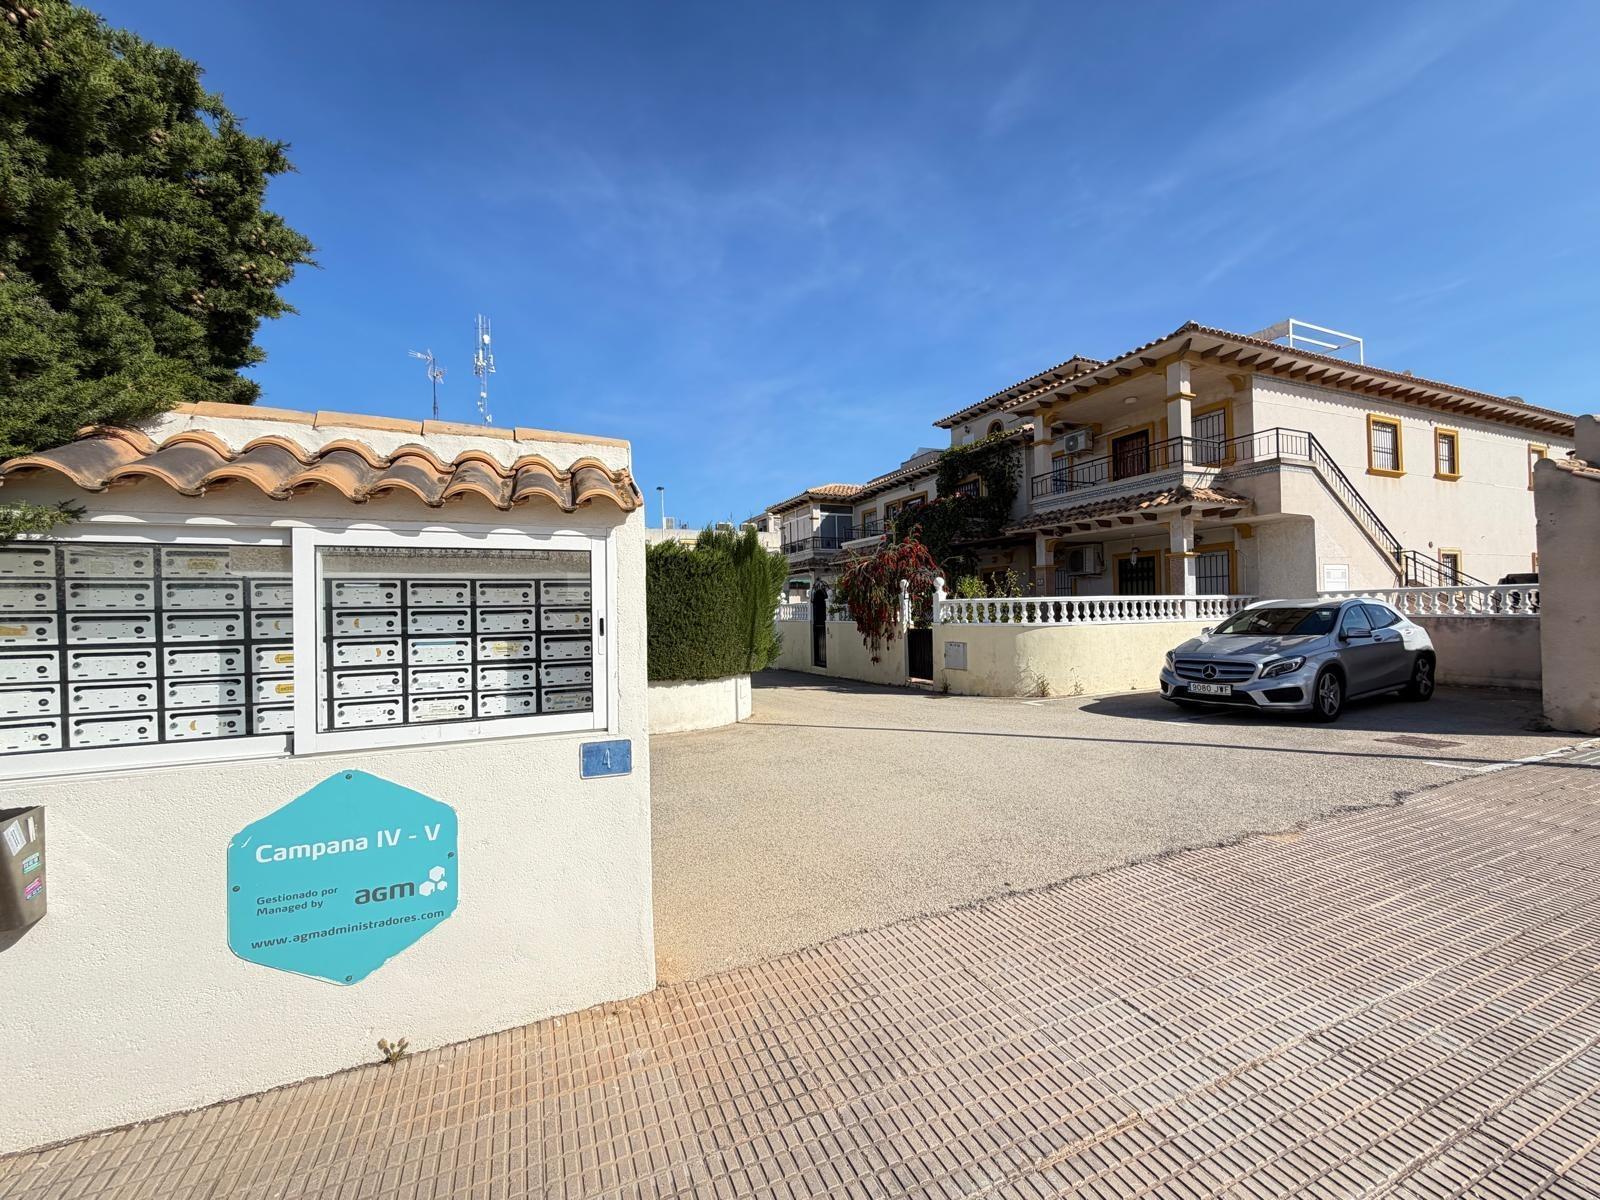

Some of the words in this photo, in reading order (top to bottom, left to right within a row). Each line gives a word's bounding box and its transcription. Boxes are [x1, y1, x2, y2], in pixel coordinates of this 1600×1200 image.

[255, 837, 368, 863] Campana
[377, 828, 401, 848] IV
[424, 823, 441, 841] V
[256, 889, 318, 905] Gestionado
[321, 887, 338, 897] por
[256, 901, 308, 916] Managed
[311, 900, 324, 909] by
[250, 909, 444, 950] www.agmadministradores.com
